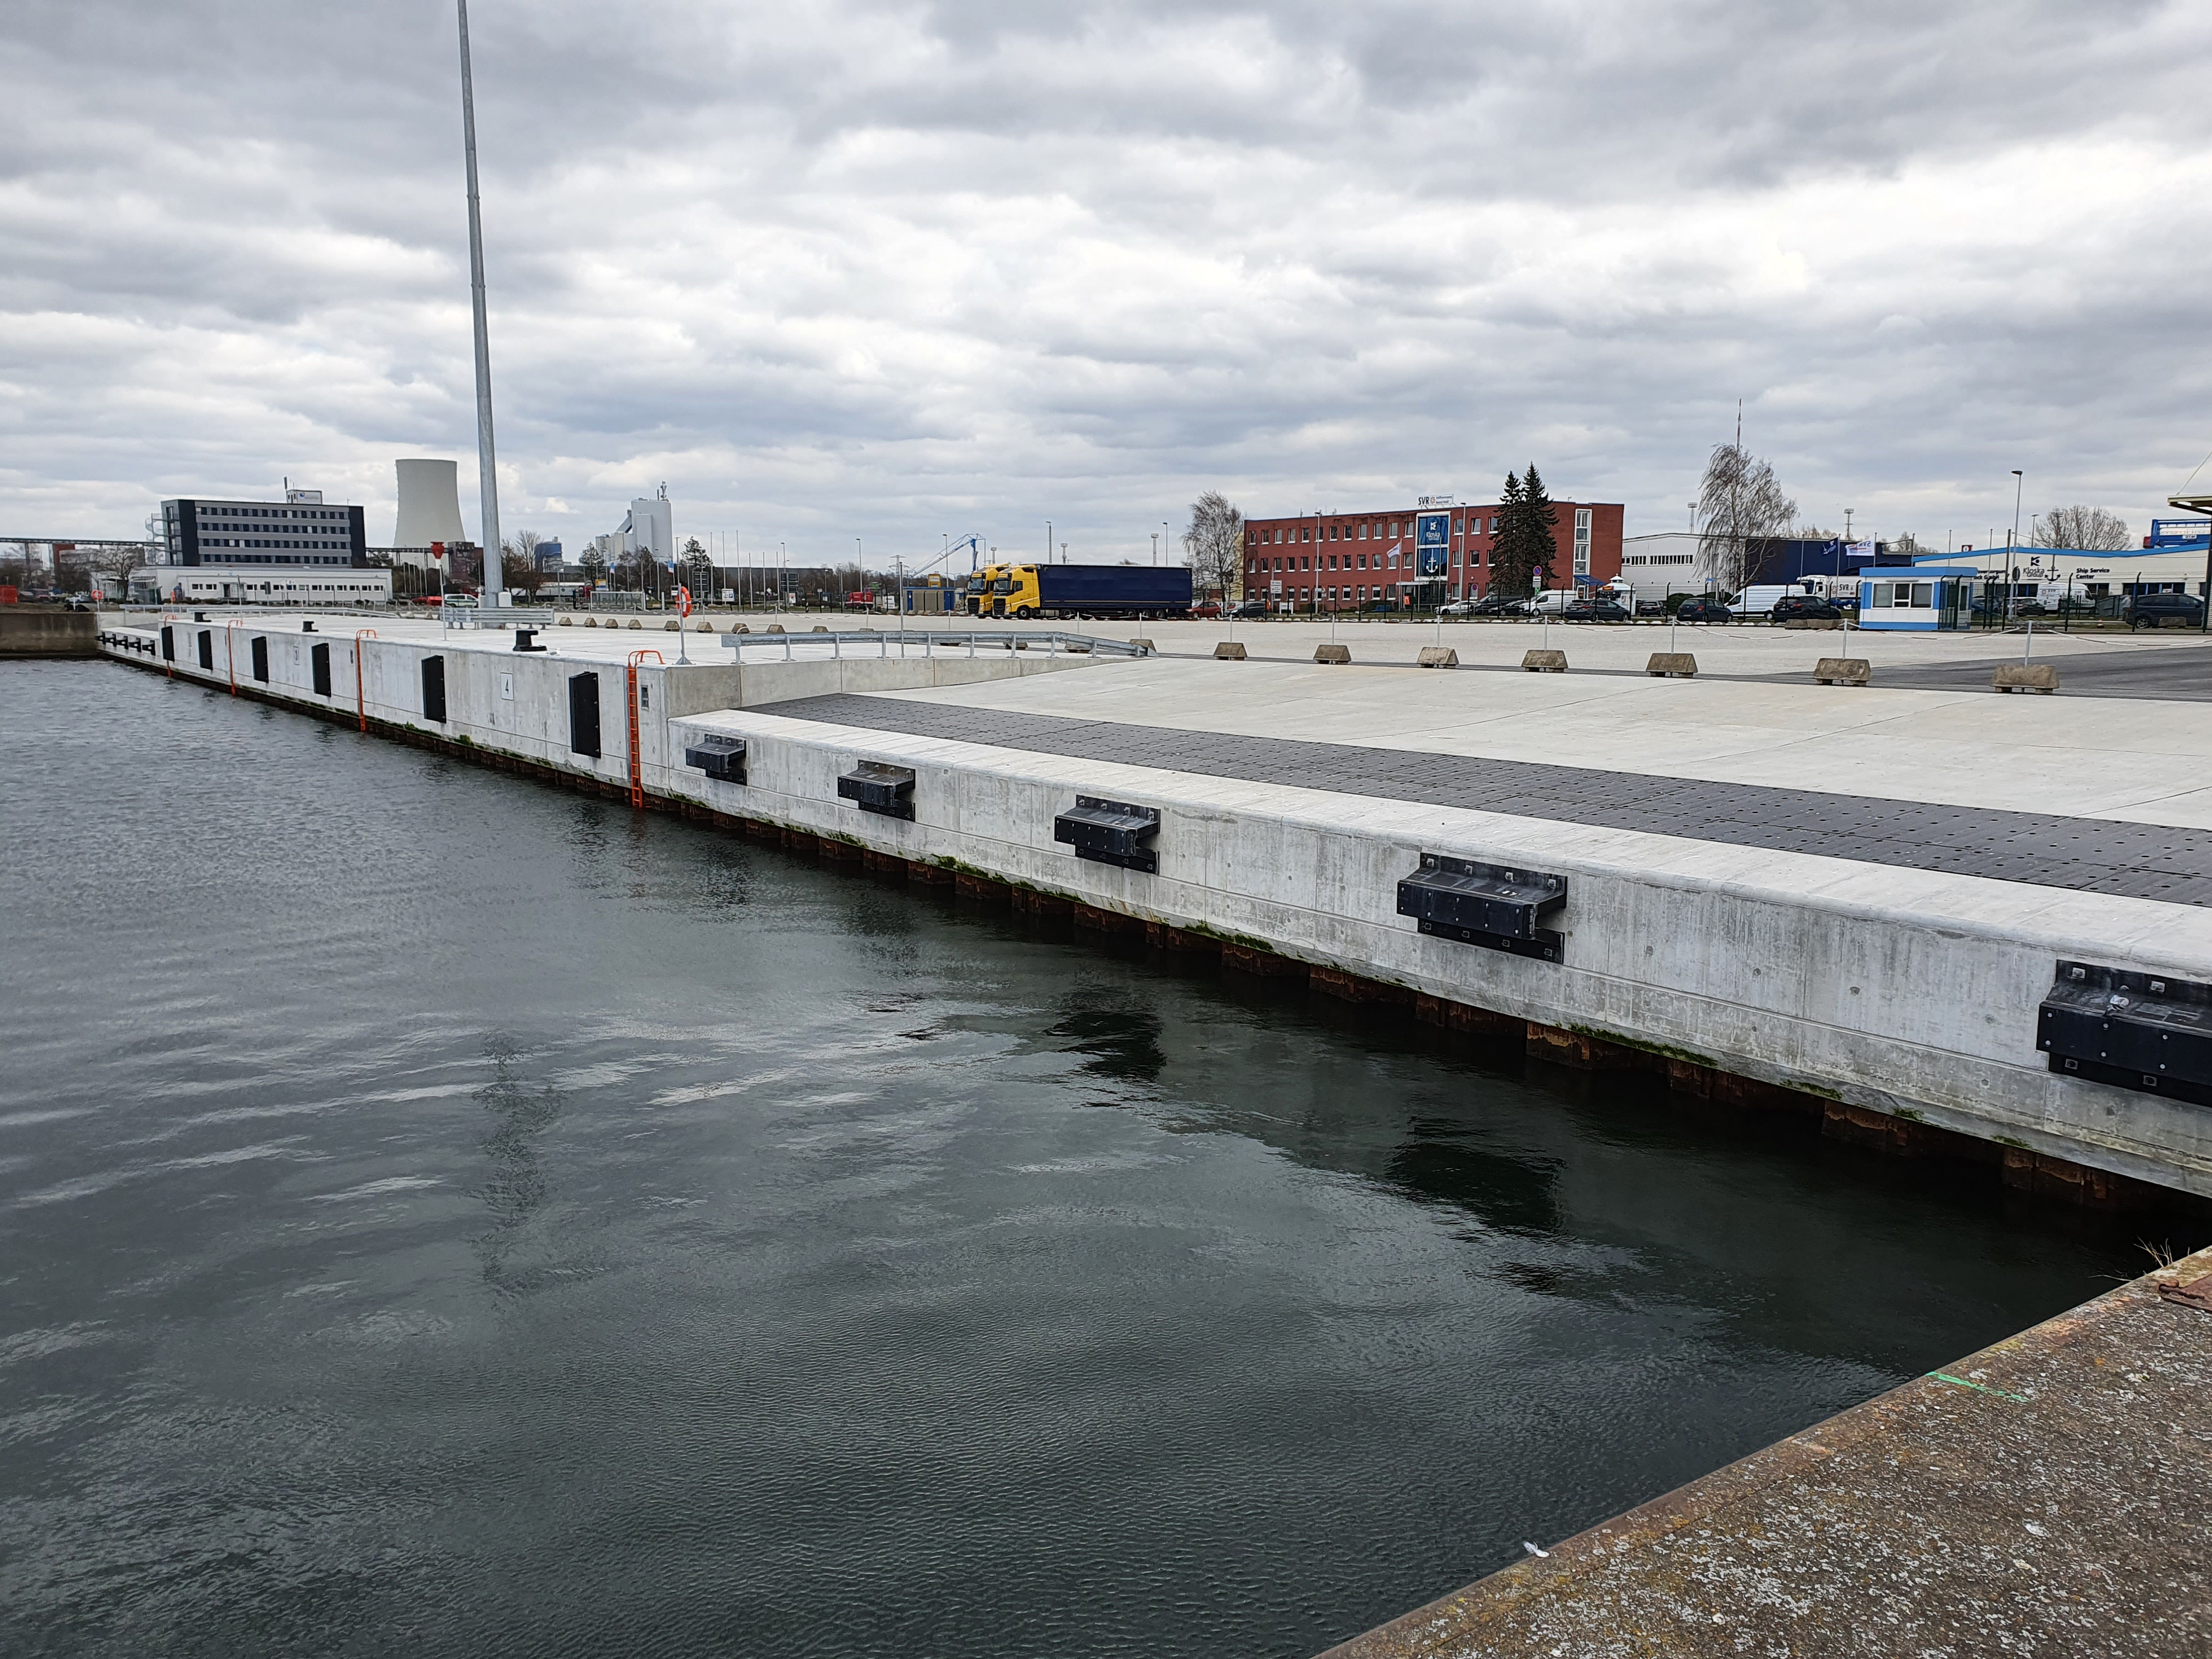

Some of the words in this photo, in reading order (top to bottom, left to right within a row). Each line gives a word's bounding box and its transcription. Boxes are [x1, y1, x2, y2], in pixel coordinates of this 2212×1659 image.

[1418, 496, 1430, 505] SVR
[2023, 567, 2045, 575] Kloska
[505, 679, 509, 694] 4
